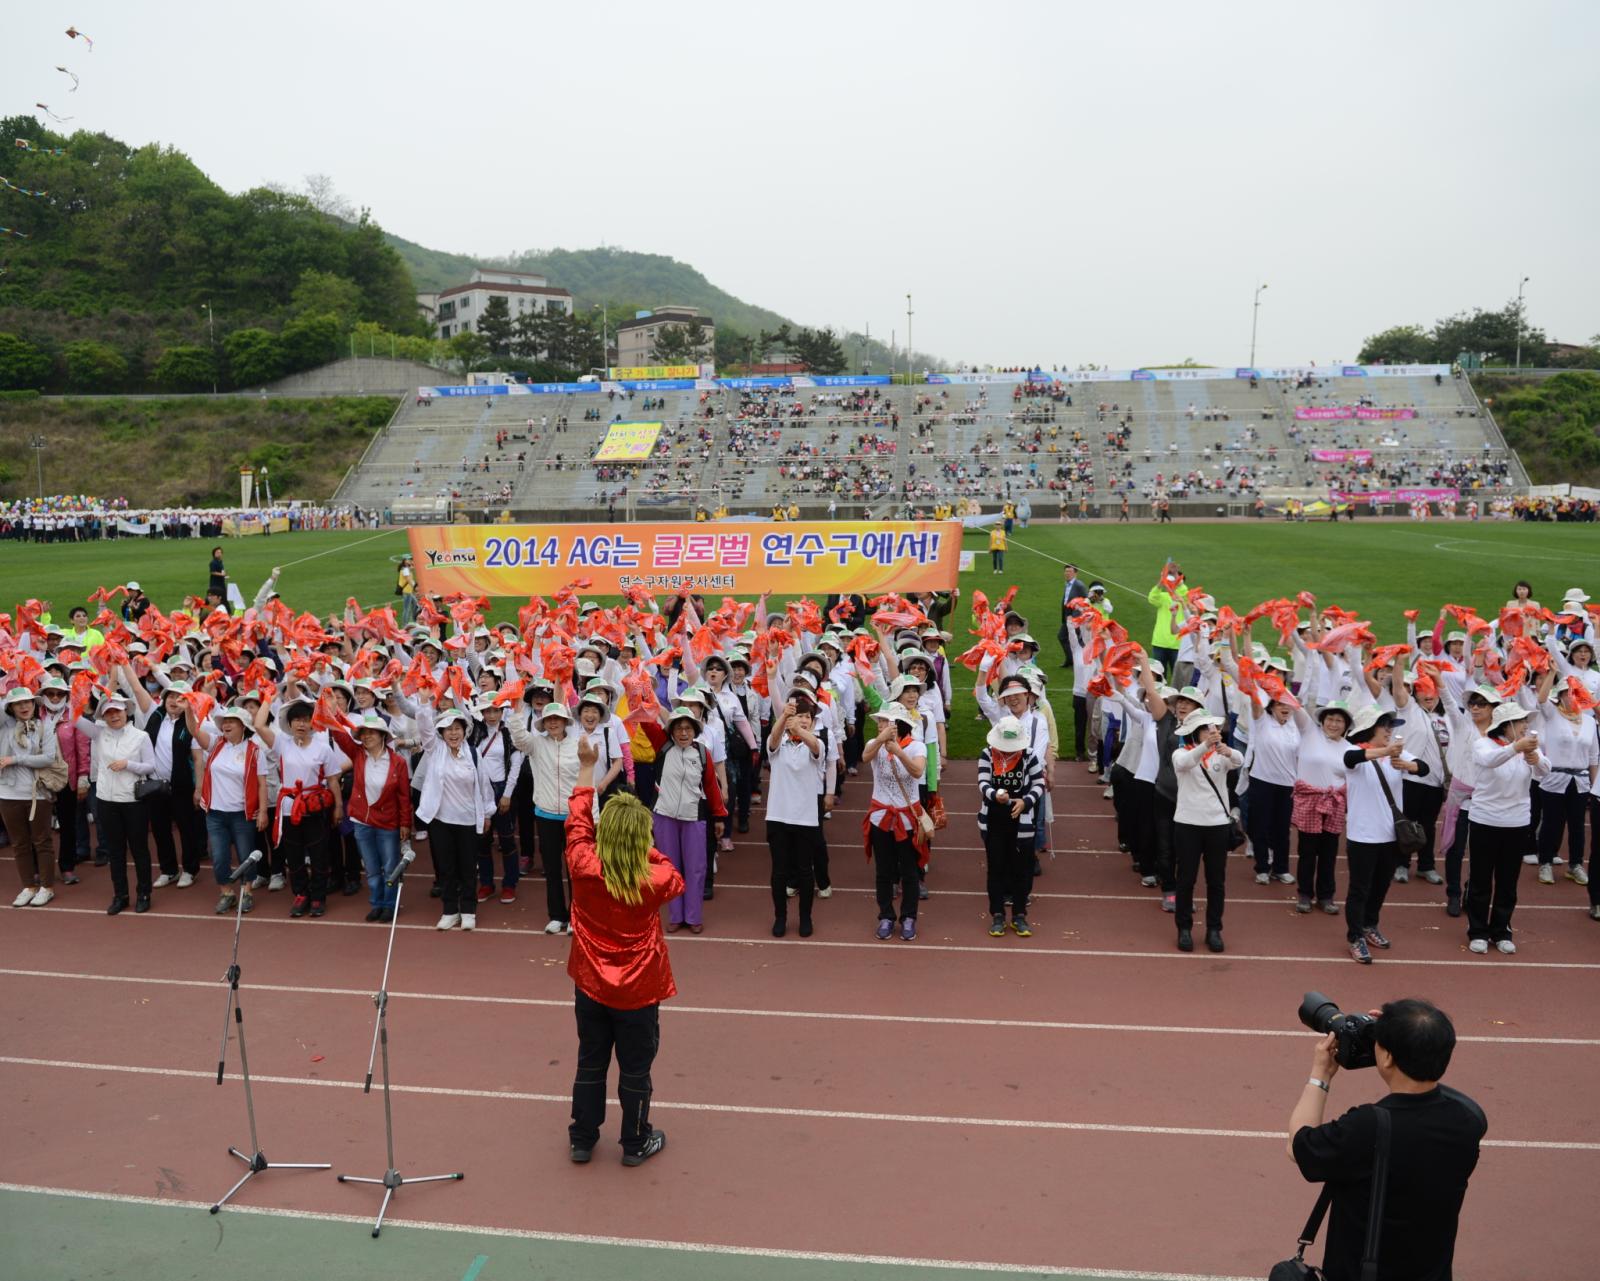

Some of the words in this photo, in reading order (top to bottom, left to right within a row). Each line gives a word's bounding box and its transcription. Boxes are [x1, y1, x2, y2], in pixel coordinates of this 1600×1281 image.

[425, 550, 476, 566] Yeonsu
[484, 537, 560, 567] 2014
[567, 535, 641, 567] AG는
[653, 533, 750, 567] 글로벌
[761, 532, 940, 566] 연수구에서!
[618, 573, 735, 590] 연수구자원봉사센터
